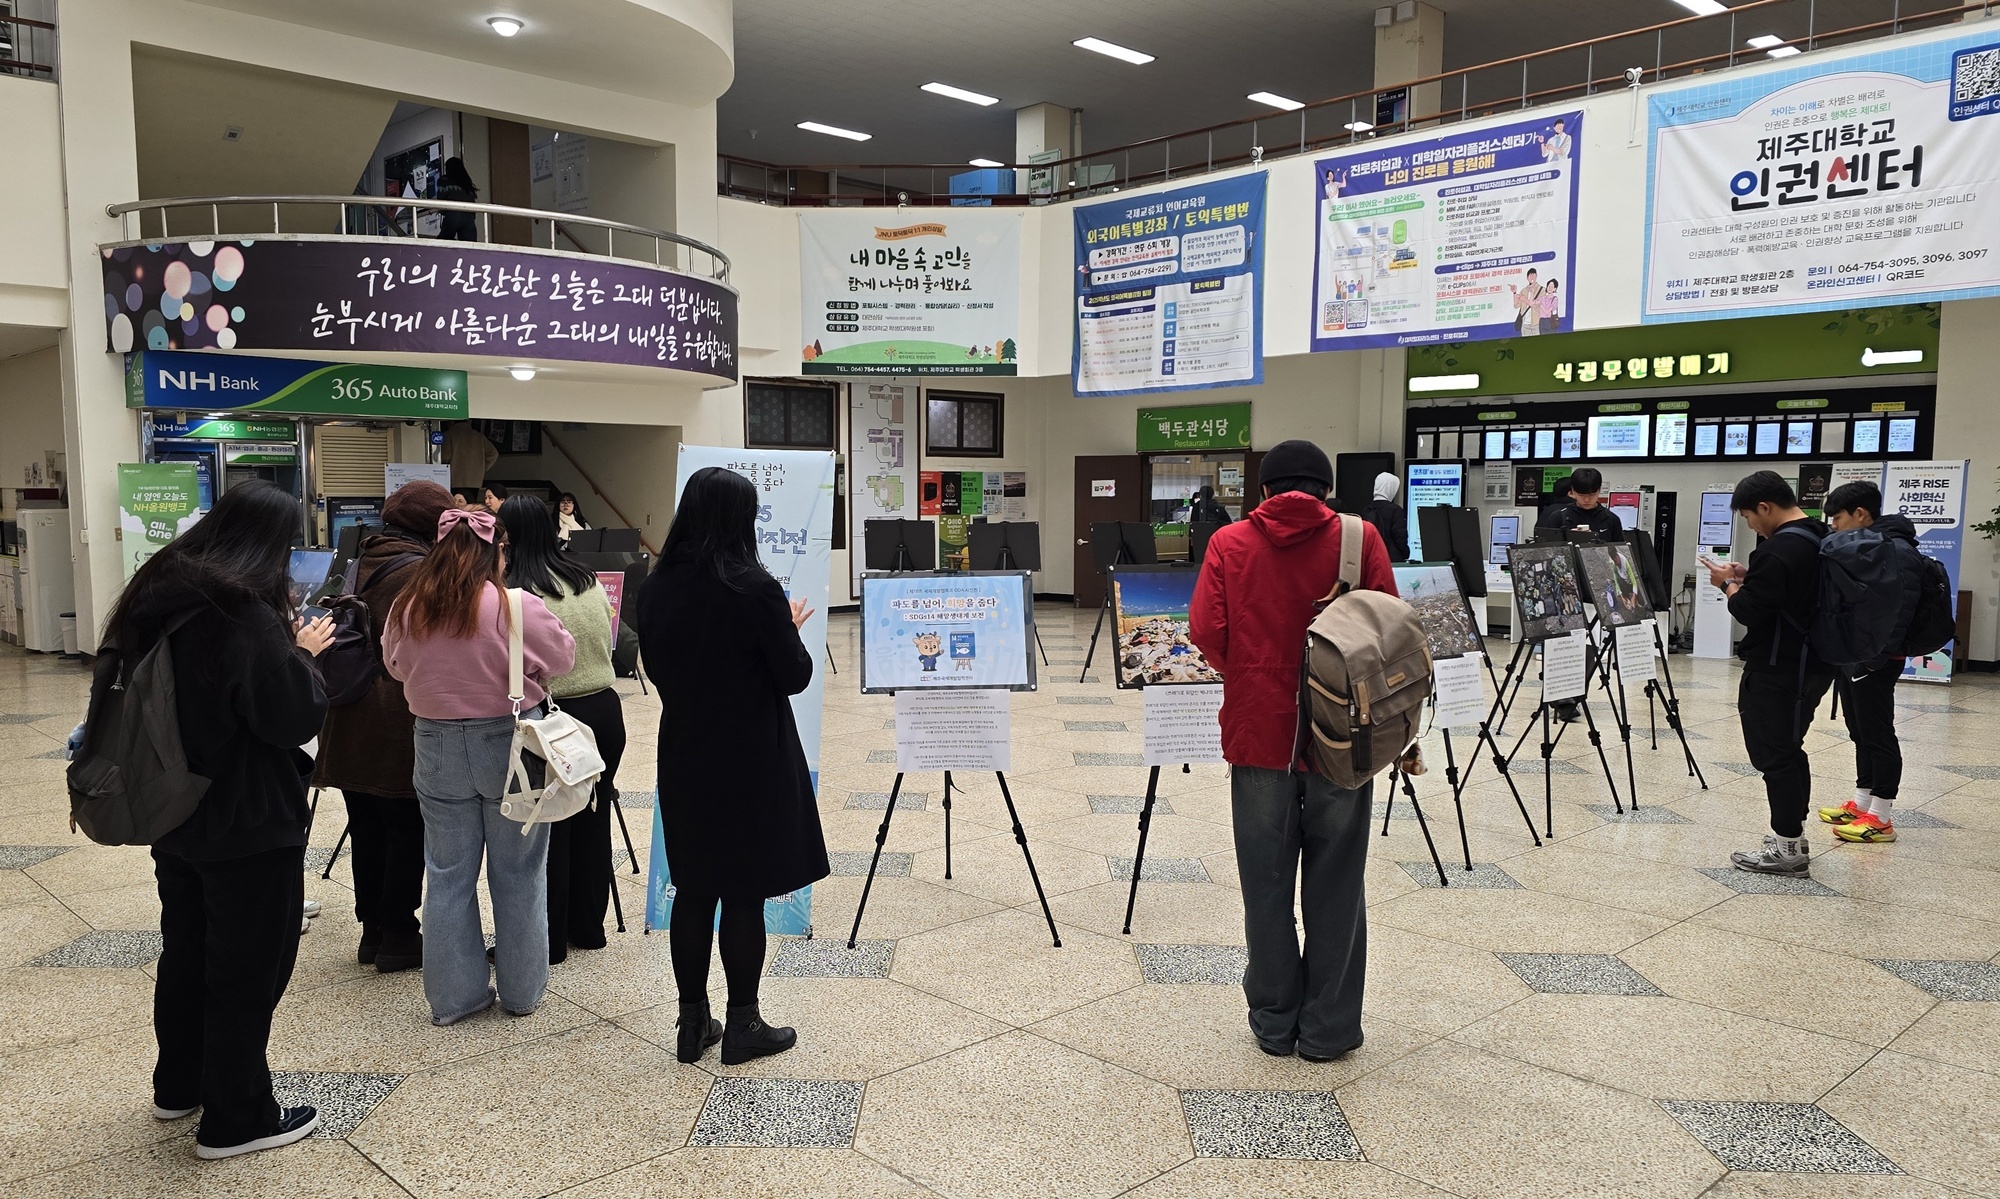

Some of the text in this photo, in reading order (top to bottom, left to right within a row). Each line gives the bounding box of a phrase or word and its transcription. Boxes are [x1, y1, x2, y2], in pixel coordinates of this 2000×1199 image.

[1771, 89, 1886, 117] 차이는 이해로 차별은 배려로
[1953, 100, 1989, 116] 인권센터
[1765, 102, 1891, 131] 인권은 존중으로 행복은 제대로!
[1756, 118, 1896, 162] 제주대학교
[1350, 156, 1403, 178] 진로취업과
[1412, 131, 1538, 168] 대학일자리플러스센터가
[1384, 153, 1496, 186] 너의 진로를 응원해!
[1730, 145, 1923, 212] 인권센터
[1125, 195, 1206, 219] 국제교류처 언어교육원
[1681, 192, 1977, 237] 인권센터는 대학 구성원의 인권 보호 및 증진을 위해 활동하는 기관입니다
[1086, 216, 1168, 244] 외국어특별강좌
[1185, 201, 1250, 227] 토익특별반
[1730, 214, 1917, 244] 서로 배려하고 존중하는 대학 문화 조성을 위해
[1688, 221, 1964, 260] 인권침해상담 폭력예방교육 인권향상 교육프로그램을 지원합니다
[850, 245, 971, 272] 내 마음 속 고민을
[1807, 249, 1989, 276] 문의 064-754-3095, 3096, 3097
[1129, 264, 1172, 277] 064-754-2291
[1666, 269, 1795, 289] 위치 제주대학교 학생회관 2층
[1807, 269, 1925, 290] 온라인신고센터 QR코드
[357, 257, 723, 325] 우리의 찬란한 오늘은 그대 덕분입니다.
[848, 274, 972, 294] 함께 나누며 풀어봐요
[1665, 284, 1779, 301] 상담방법 전화 및 방문상담
[309, 300, 733, 368] 눈부시게 아름다운 그대의 내일을 응원합니다.
[1553, 351, 1730, 383] 식권무인발매기
[159, 369, 458, 402] NH Bank 365 Auto Bank
[153, 424, 174, 432] NH
[217, 423, 236, 433] 365
[1158, 418, 1229, 438] 백두관식당
[1174, 439, 1210, 448] Restaurant
[726, 462, 786, 477] 파도를 넘어,
[762, 479, 785, 492] 줍다
[1899, 479, 1950, 488] 제주 RISE
[132, 492, 189, 502] 내 옆엔 오늘도
[1899, 492, 1946, 503] 사회혁신
[133, 502, 187, 513] NH올원뱅크
[1898, 504, 1945, 515] 요구조사
[148, 529, 173, 540] one
[150, 521, 166, 531] all
[892, 598, 997, 609] 파도를 넘어, 희망을 줍다
